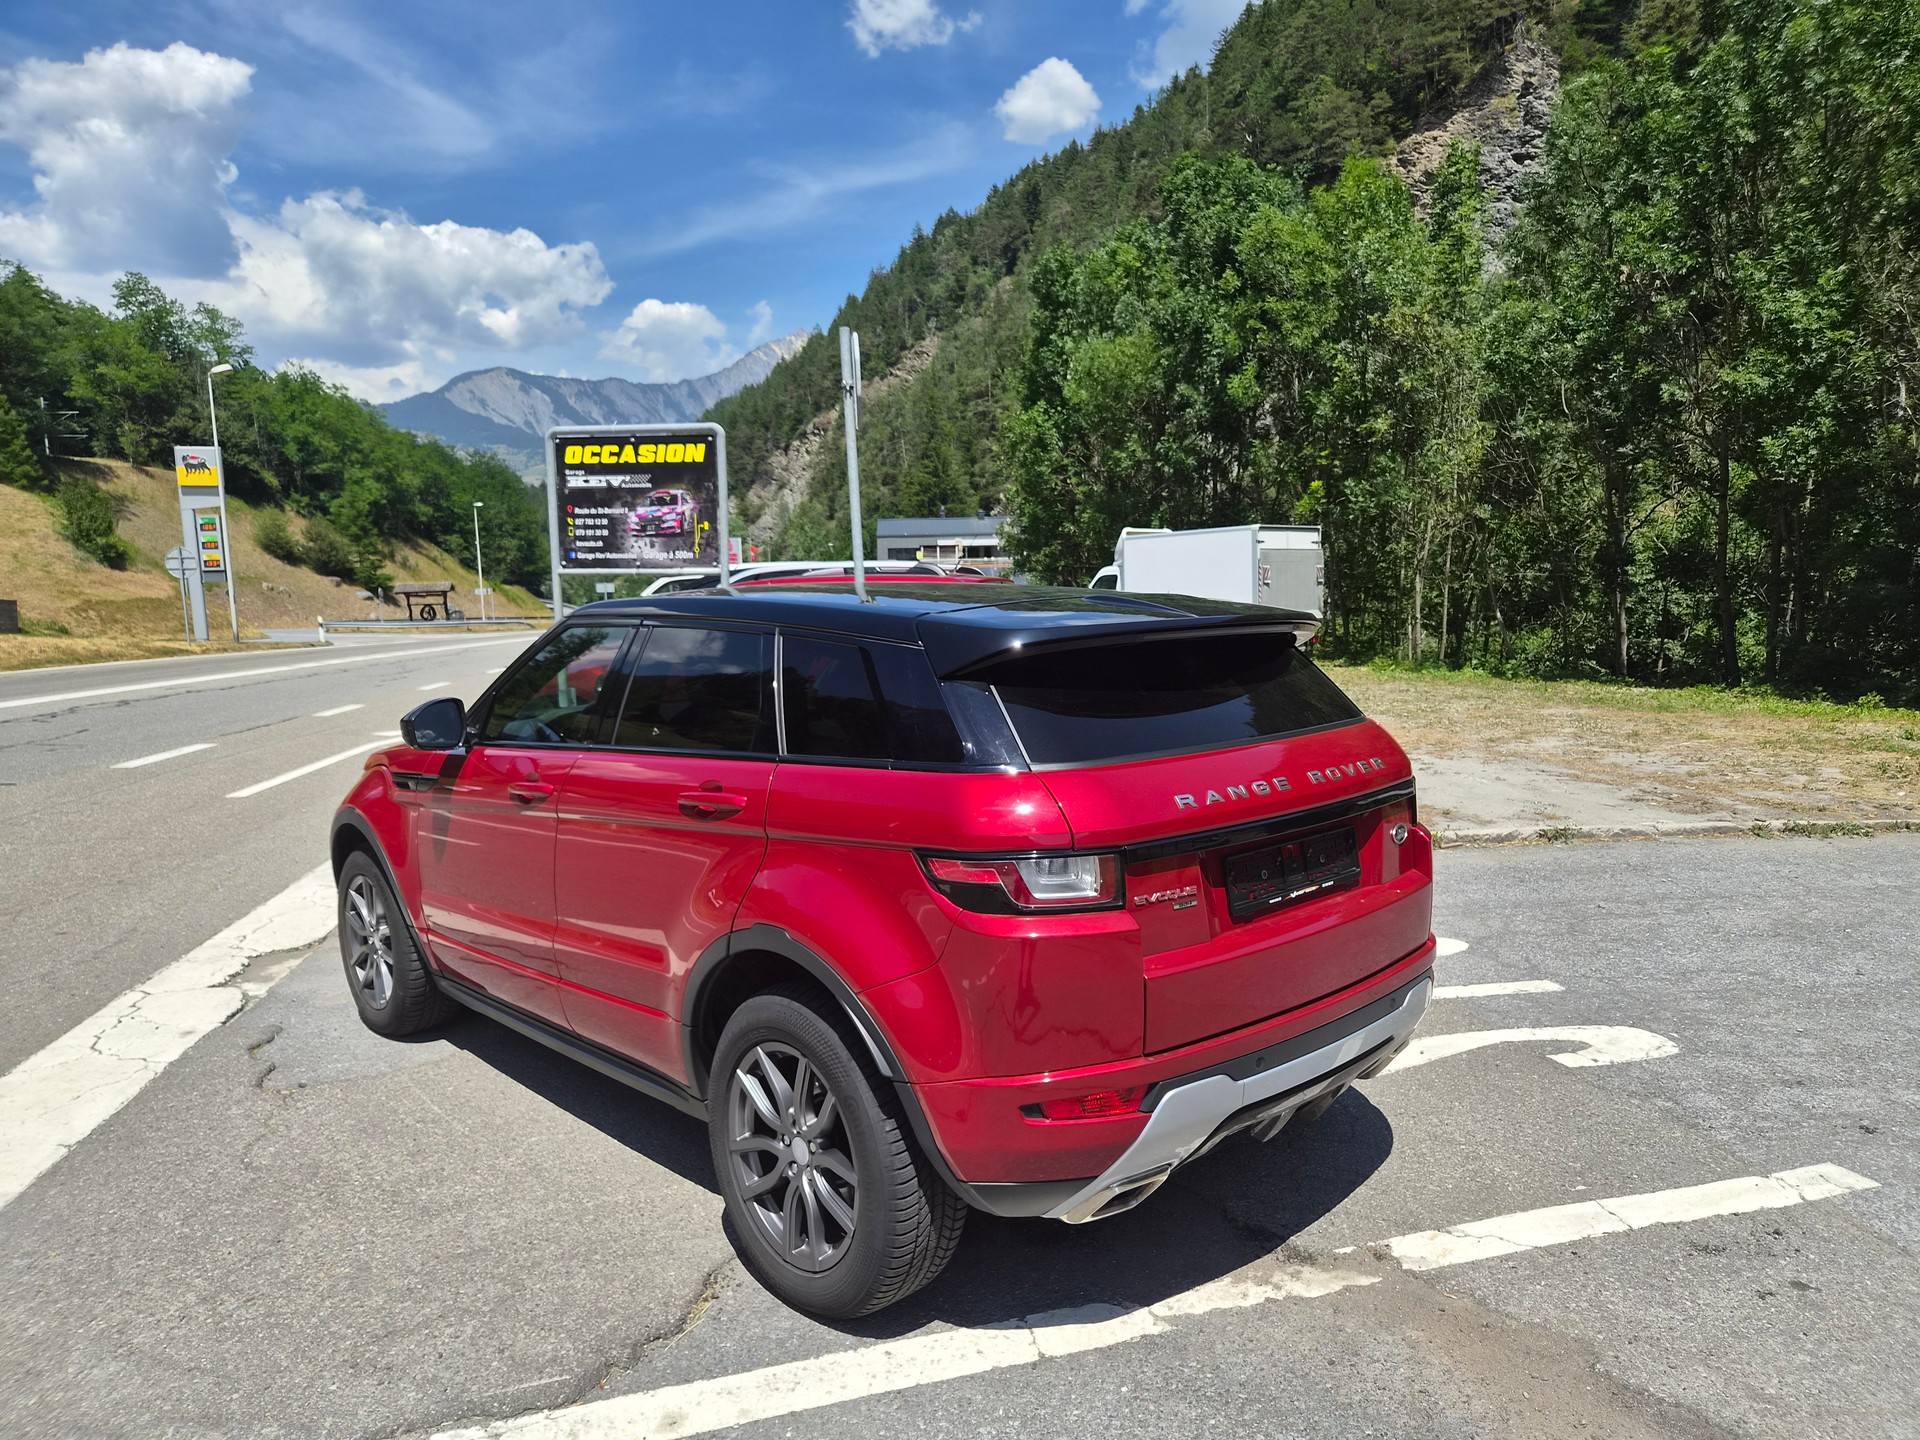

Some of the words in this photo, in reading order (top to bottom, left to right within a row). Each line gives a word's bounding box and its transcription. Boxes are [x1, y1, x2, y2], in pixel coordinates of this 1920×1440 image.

[564, 443, 706, 464] OCCASION
[577, 552, 595, 560] Garage
[643, 550, 668, 561] Garage
[669, 550, 673, 559] à
[675, 551, 694, 559] 500m
[1174, 776, 1292, 811] RANGE
[1307, 757, 1386, 785] ROVER
[1134, 885, 1198, 906] EVOQUE
